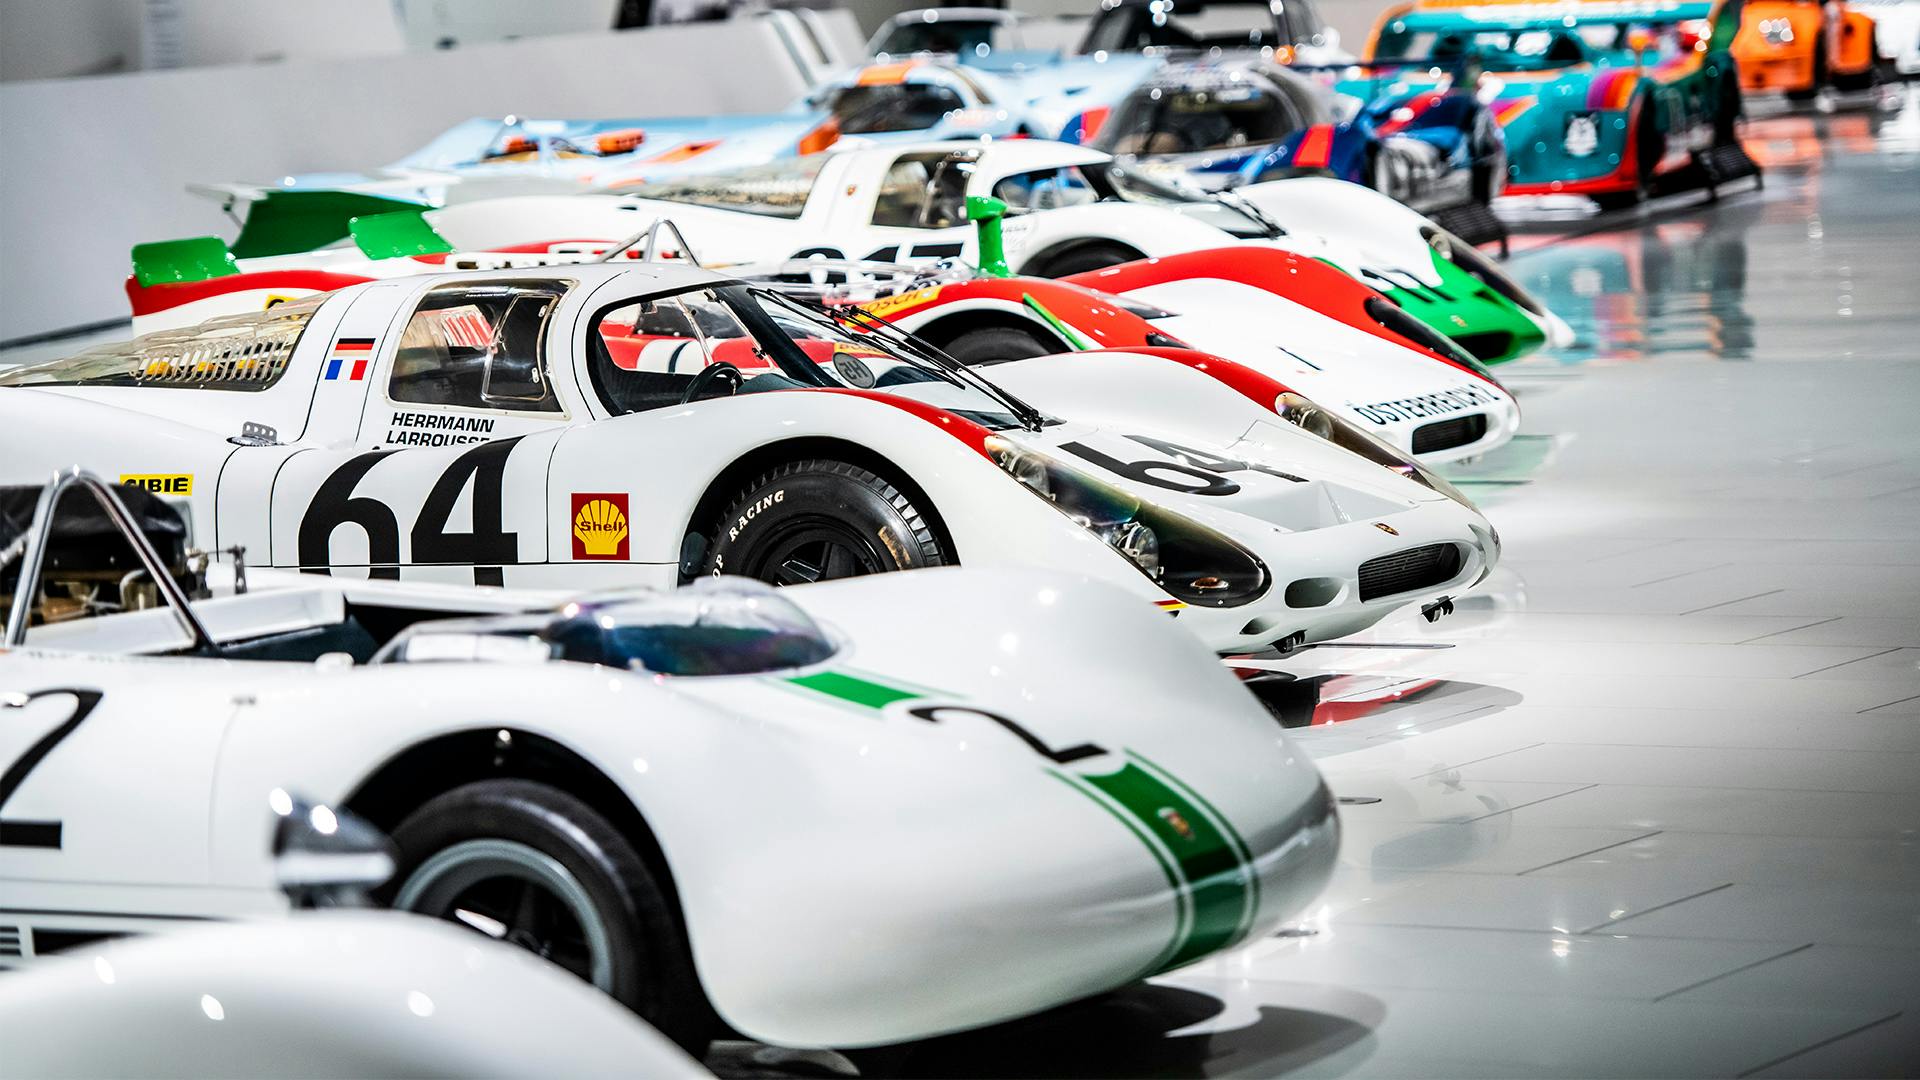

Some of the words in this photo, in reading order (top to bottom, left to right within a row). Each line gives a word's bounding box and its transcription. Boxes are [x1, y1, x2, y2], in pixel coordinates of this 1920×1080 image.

[386, 430, 490, 447] LARROUSS
[391, 412, 495, 433] HERRMANN
[1057, 434, 1311, 496] 64
[298, 434, 528, 588] 64
[580, 521, 623, 532] Shell
[729, 490, 784, 542] RACING
[908, 706, 1109, 764] 2
[0, 687, 104, 850] 2
